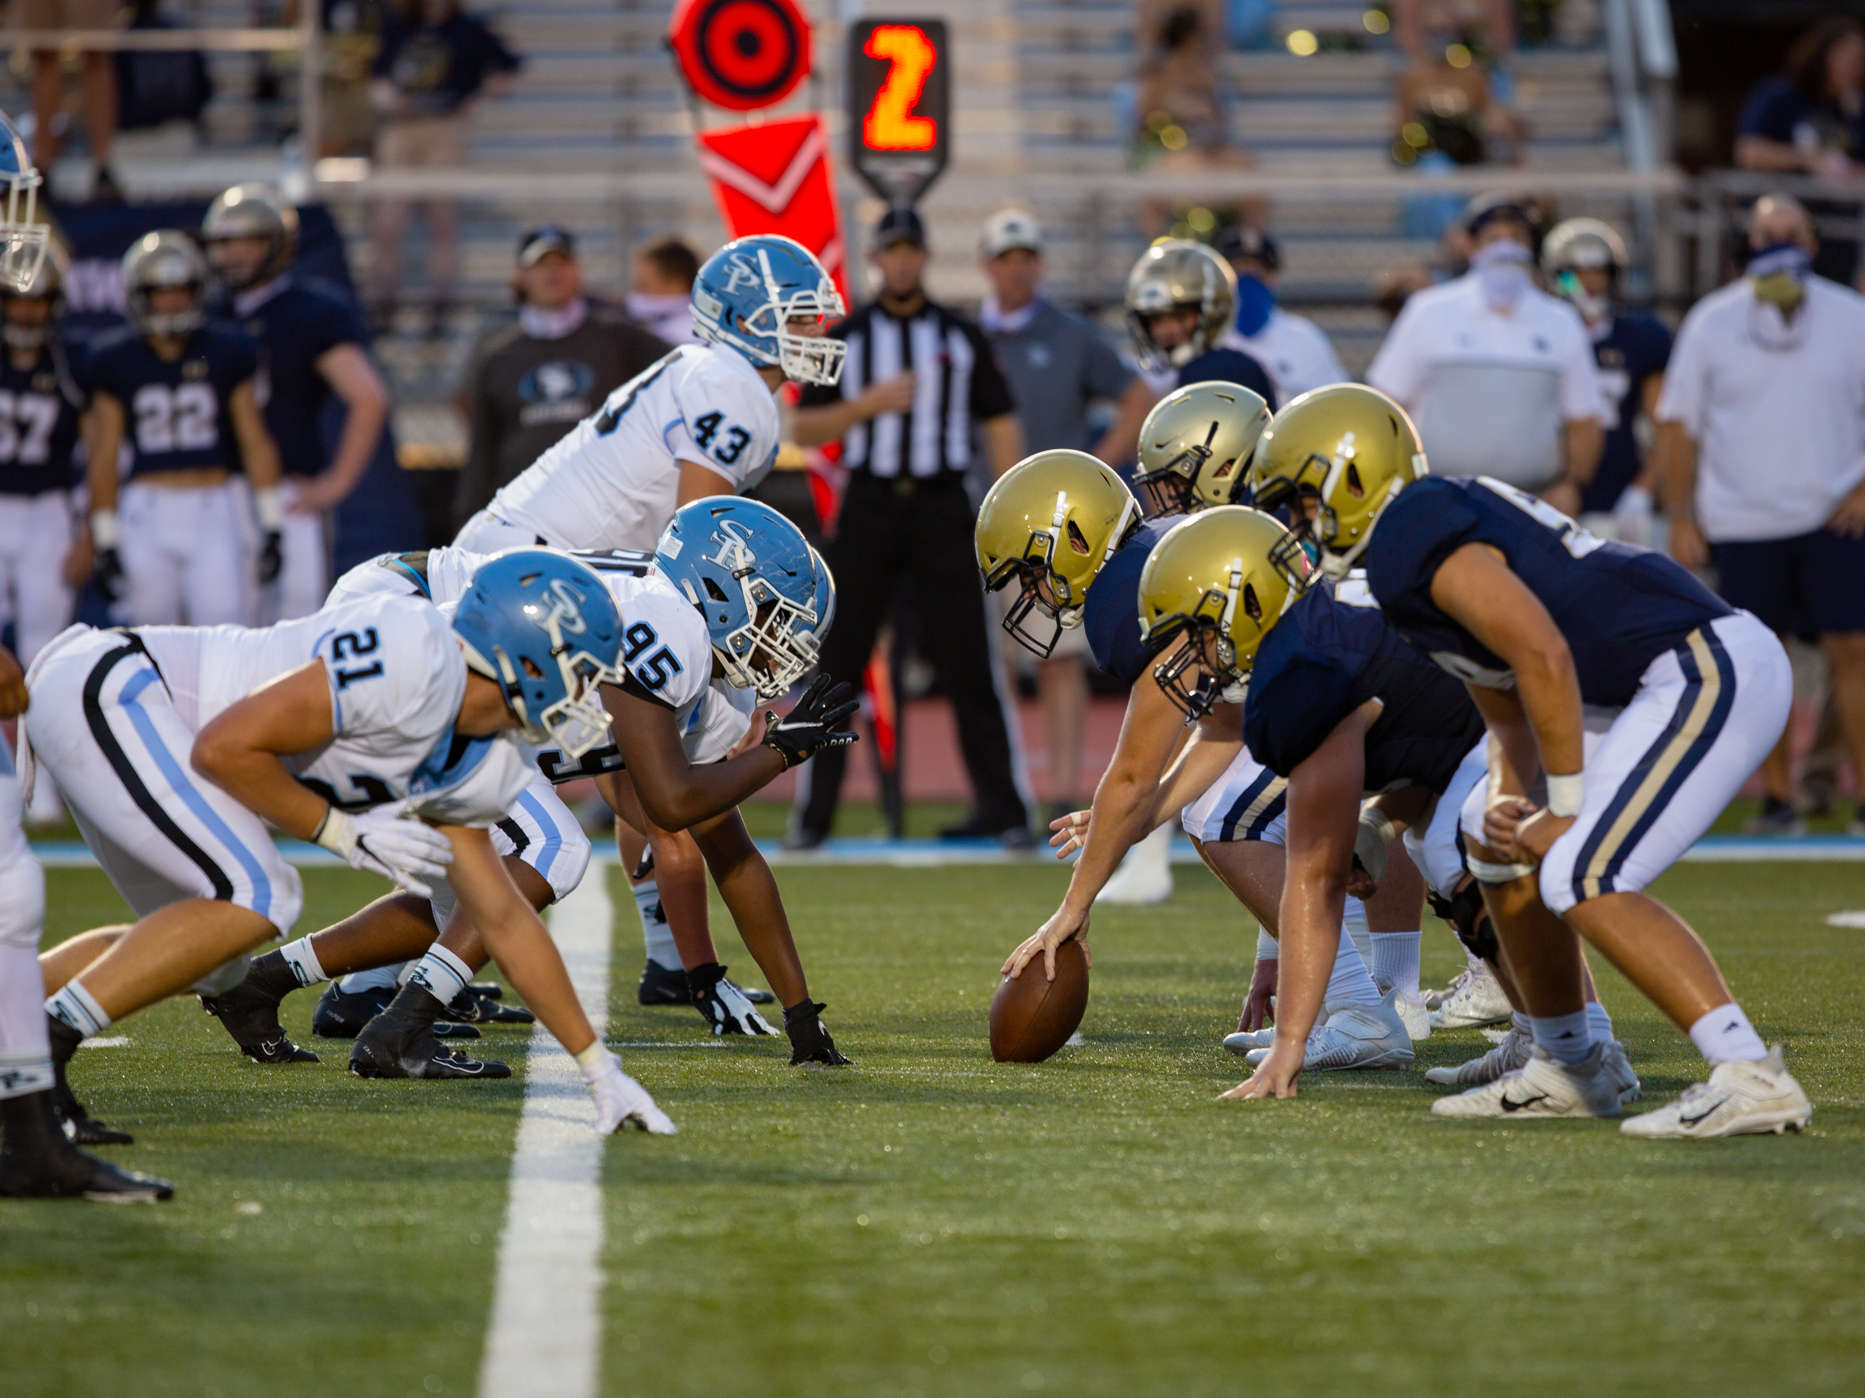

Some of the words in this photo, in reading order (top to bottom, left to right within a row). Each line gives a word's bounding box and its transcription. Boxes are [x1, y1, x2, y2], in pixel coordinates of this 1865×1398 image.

[863, 24, 938, 151] 2
[132, 383, 218, 454] 22
[694, 408, 751, 466] 43
[331, 626, 385, 692] 21
[622, 619, 685, 693] 95
